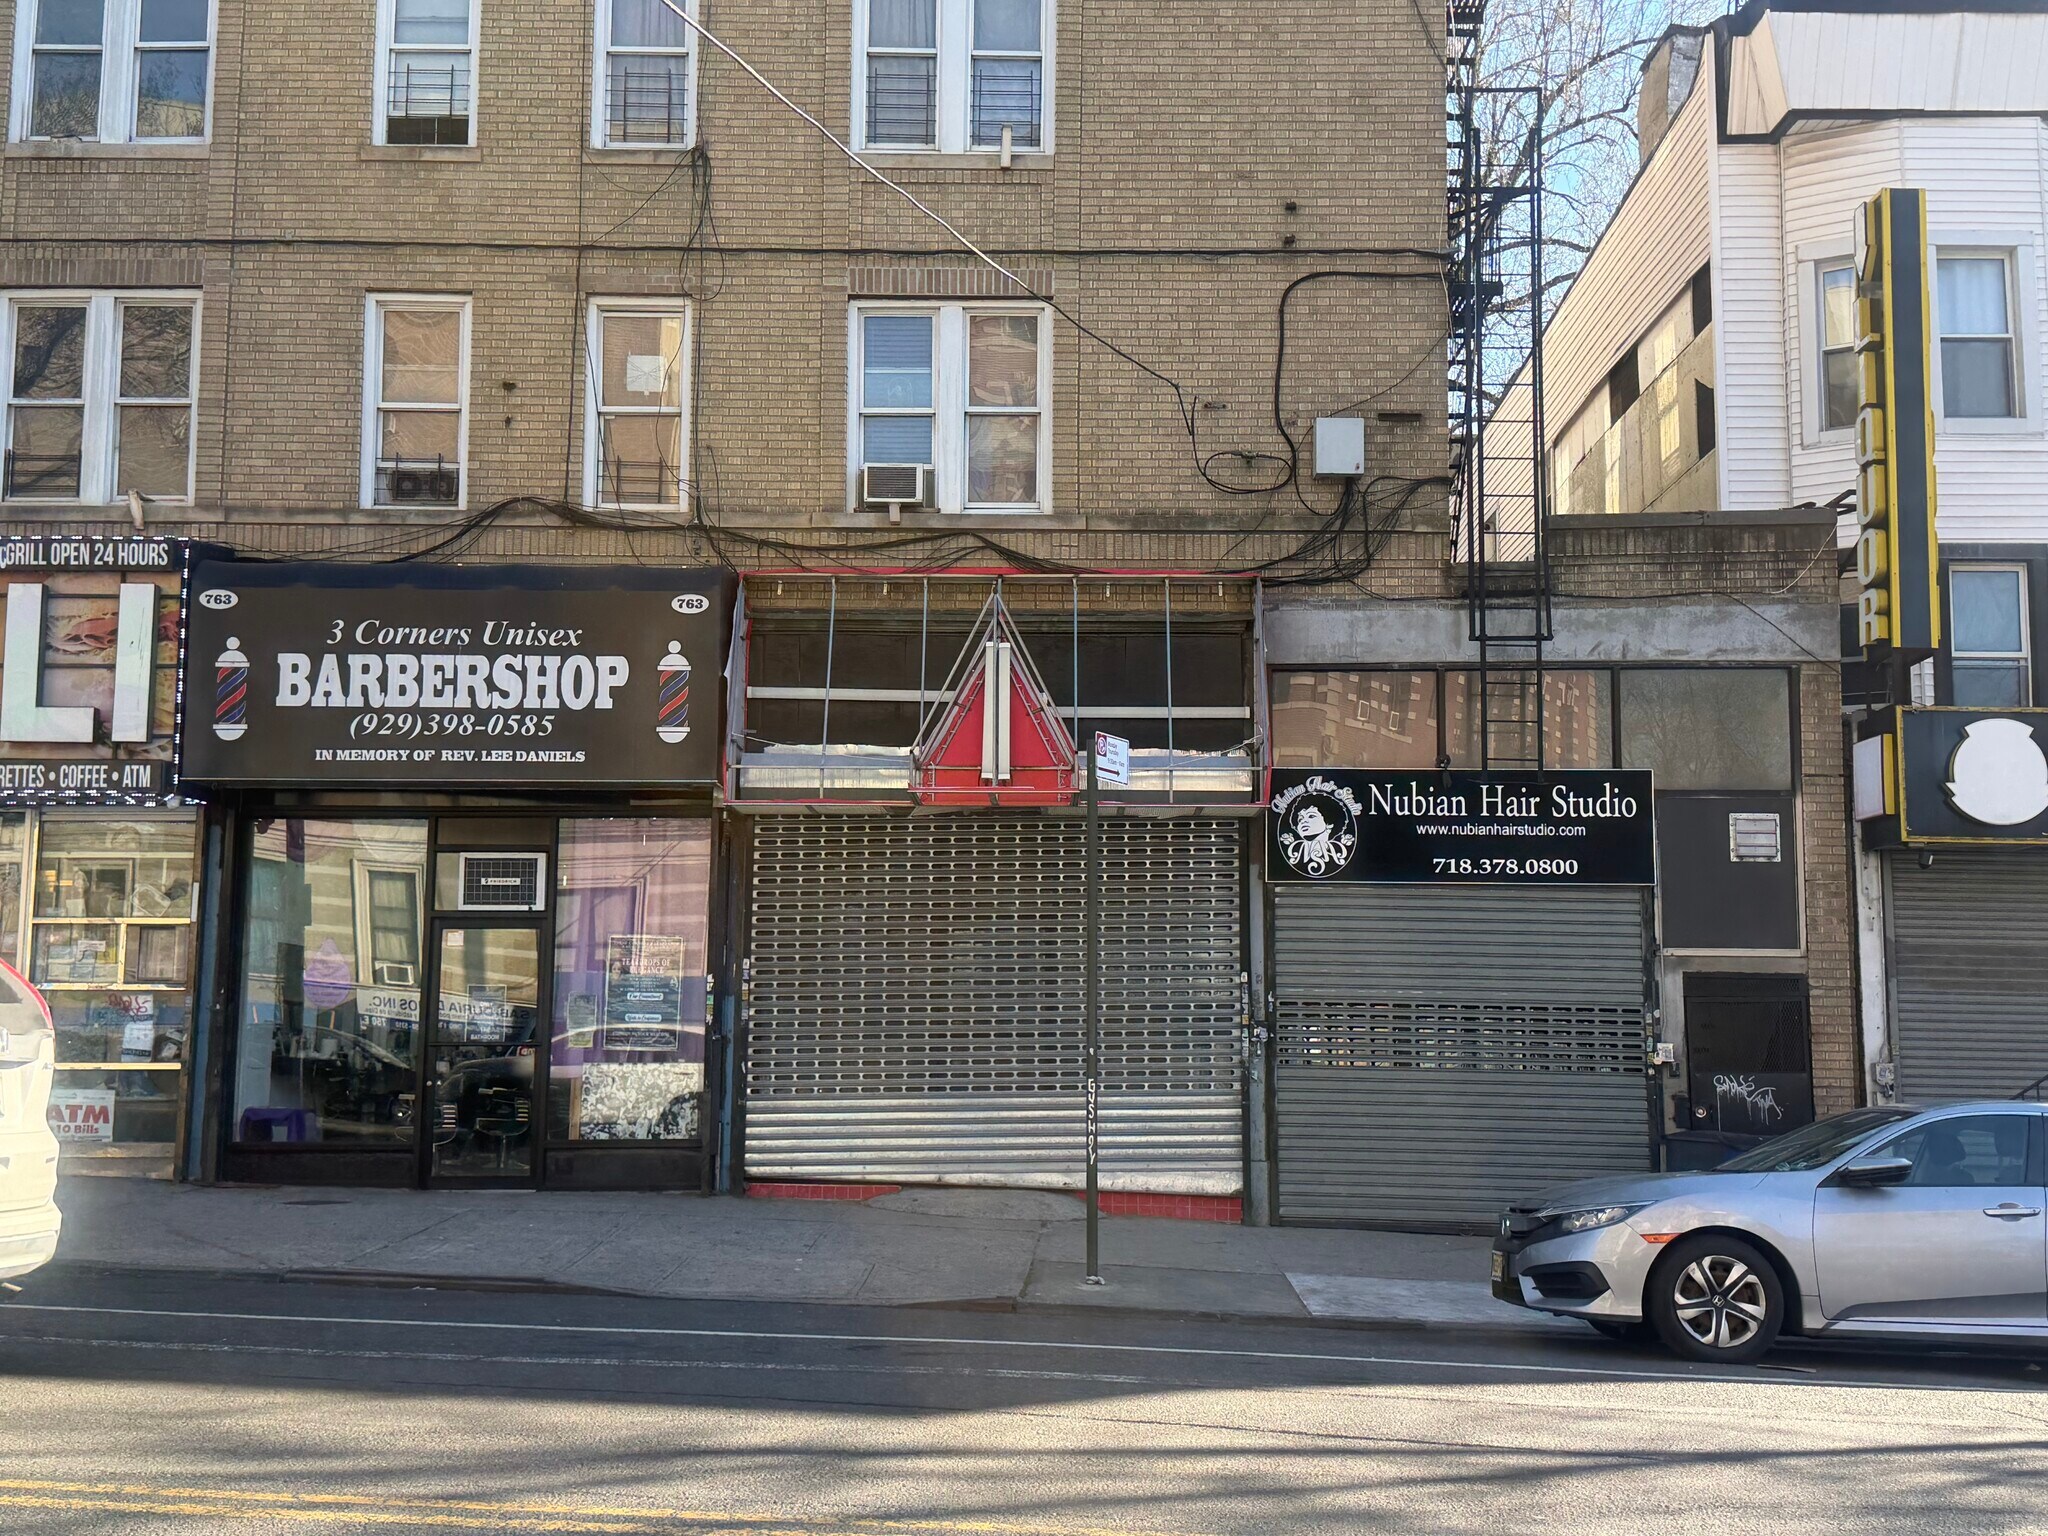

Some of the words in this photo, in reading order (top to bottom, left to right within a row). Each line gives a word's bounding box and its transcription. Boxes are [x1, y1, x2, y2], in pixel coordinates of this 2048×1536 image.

[1853, 296, 1889, 648] LIQUOR
[6, 543, 47, 566] GRILL
[51, 543, 90, 566] OPEN
[94, 543, 114, 566] 24
[118, 543, 169, 566] HOURS
[204, 593, 232, 605] 763
[677, 598, 704, 610] 763
[326, 619, 345, 645] 3
[355, 619, 472, 646] Corners
[482, 620, 583, 647] Unisex
[275, 652, 630, 711] BARBERSHOP
[350, 713, 555, 740] (929)398-0585
[315, 749, 333, 761] IN
[336, 749, 411, 761] MEMORY
[413, 749, 435, 761] OF
[441, 749, 478, 762] REV.
[481, 750, 513, 762] LEE
[515, 750, 586, 763] DANIELS
[60, 765, 108, 788] COFFEE
[122, 765, 151, 788] ATM
[1368, 781, 1468, 817] Nubian
[1480, 784, 1541, 817] Hair
[1551, 782, 1637, 818] Studio
[1416, 822, 1586, 836] www.nubianhairstudio.com
[1432, 858, 1579, 875] 718.378.0800
[47, 1104, 110, 1124] ATM
[73, 1124, 100, 1134] Bills
